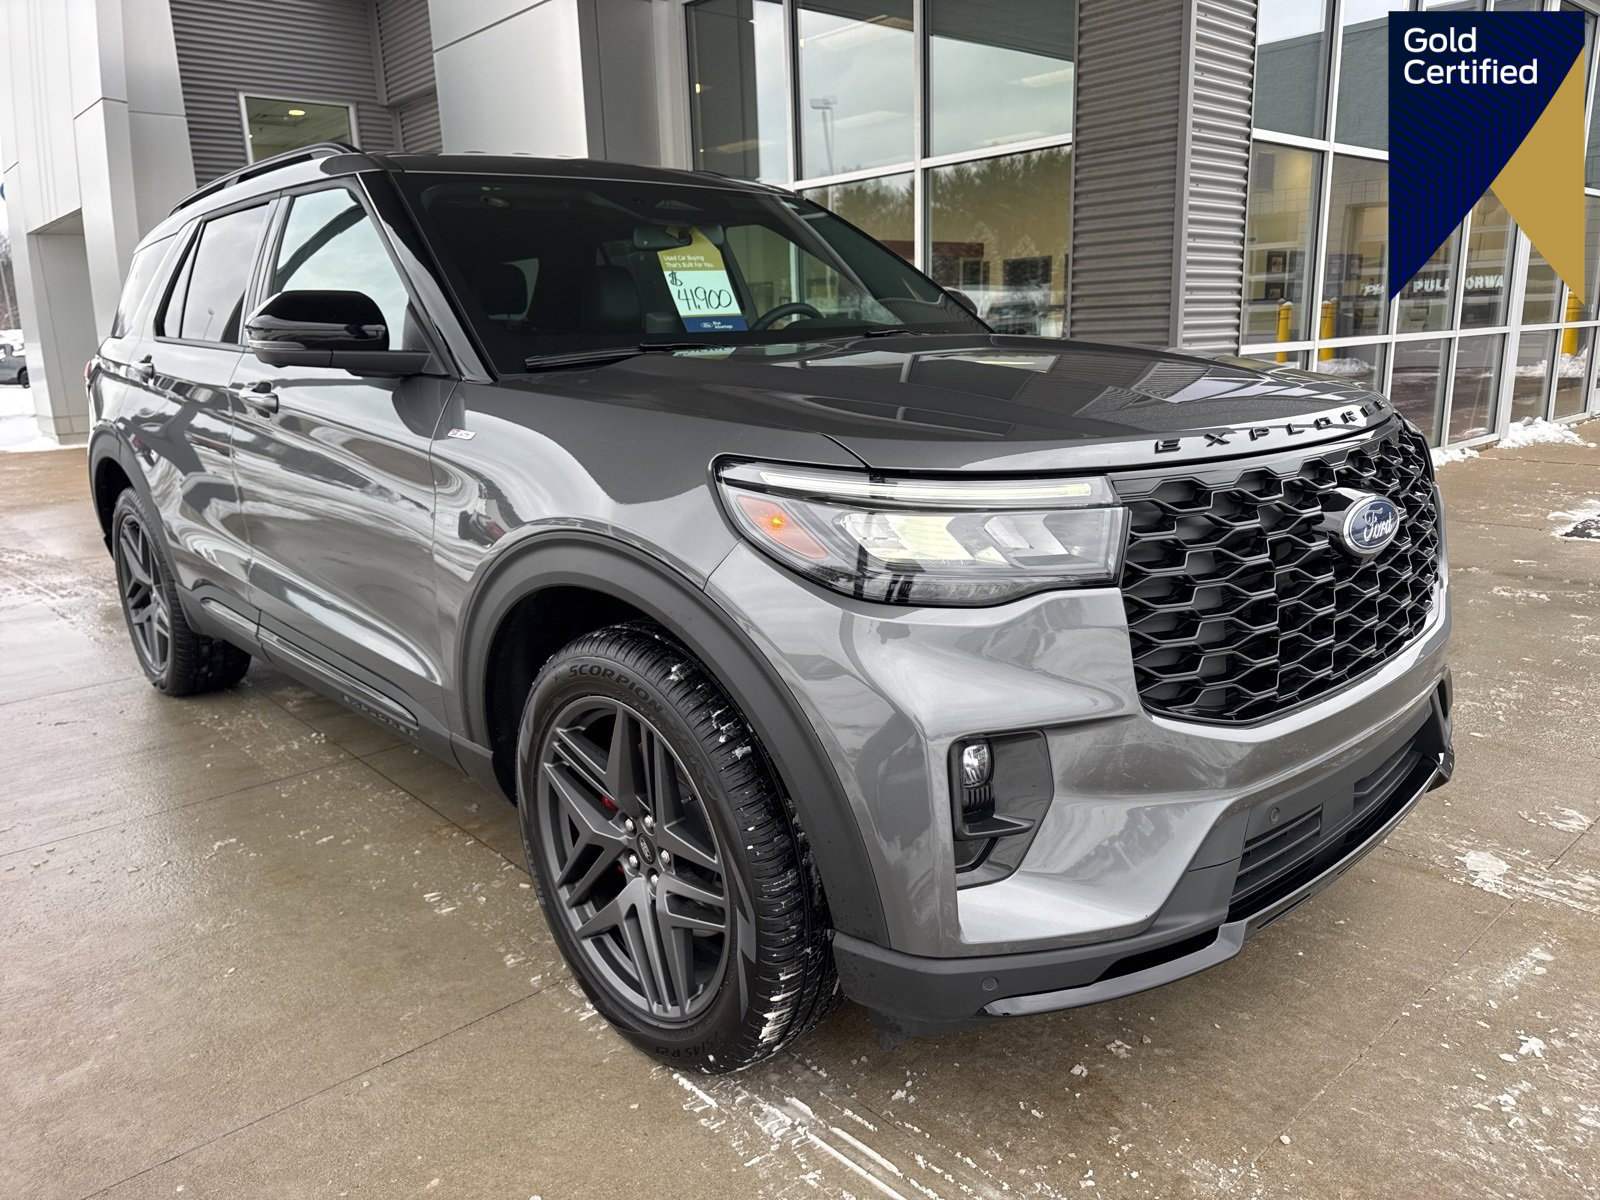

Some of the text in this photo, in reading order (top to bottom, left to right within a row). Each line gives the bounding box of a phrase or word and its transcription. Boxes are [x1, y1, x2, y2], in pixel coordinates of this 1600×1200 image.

[669, 271, 683, 286] $
[678, 287, 732, 311] 41,900
[1154, 400, 1387, 454] EXPLORER
[1363, 507, 1395, 542] Ford
[568, 664, 664, 713] SCORPION
